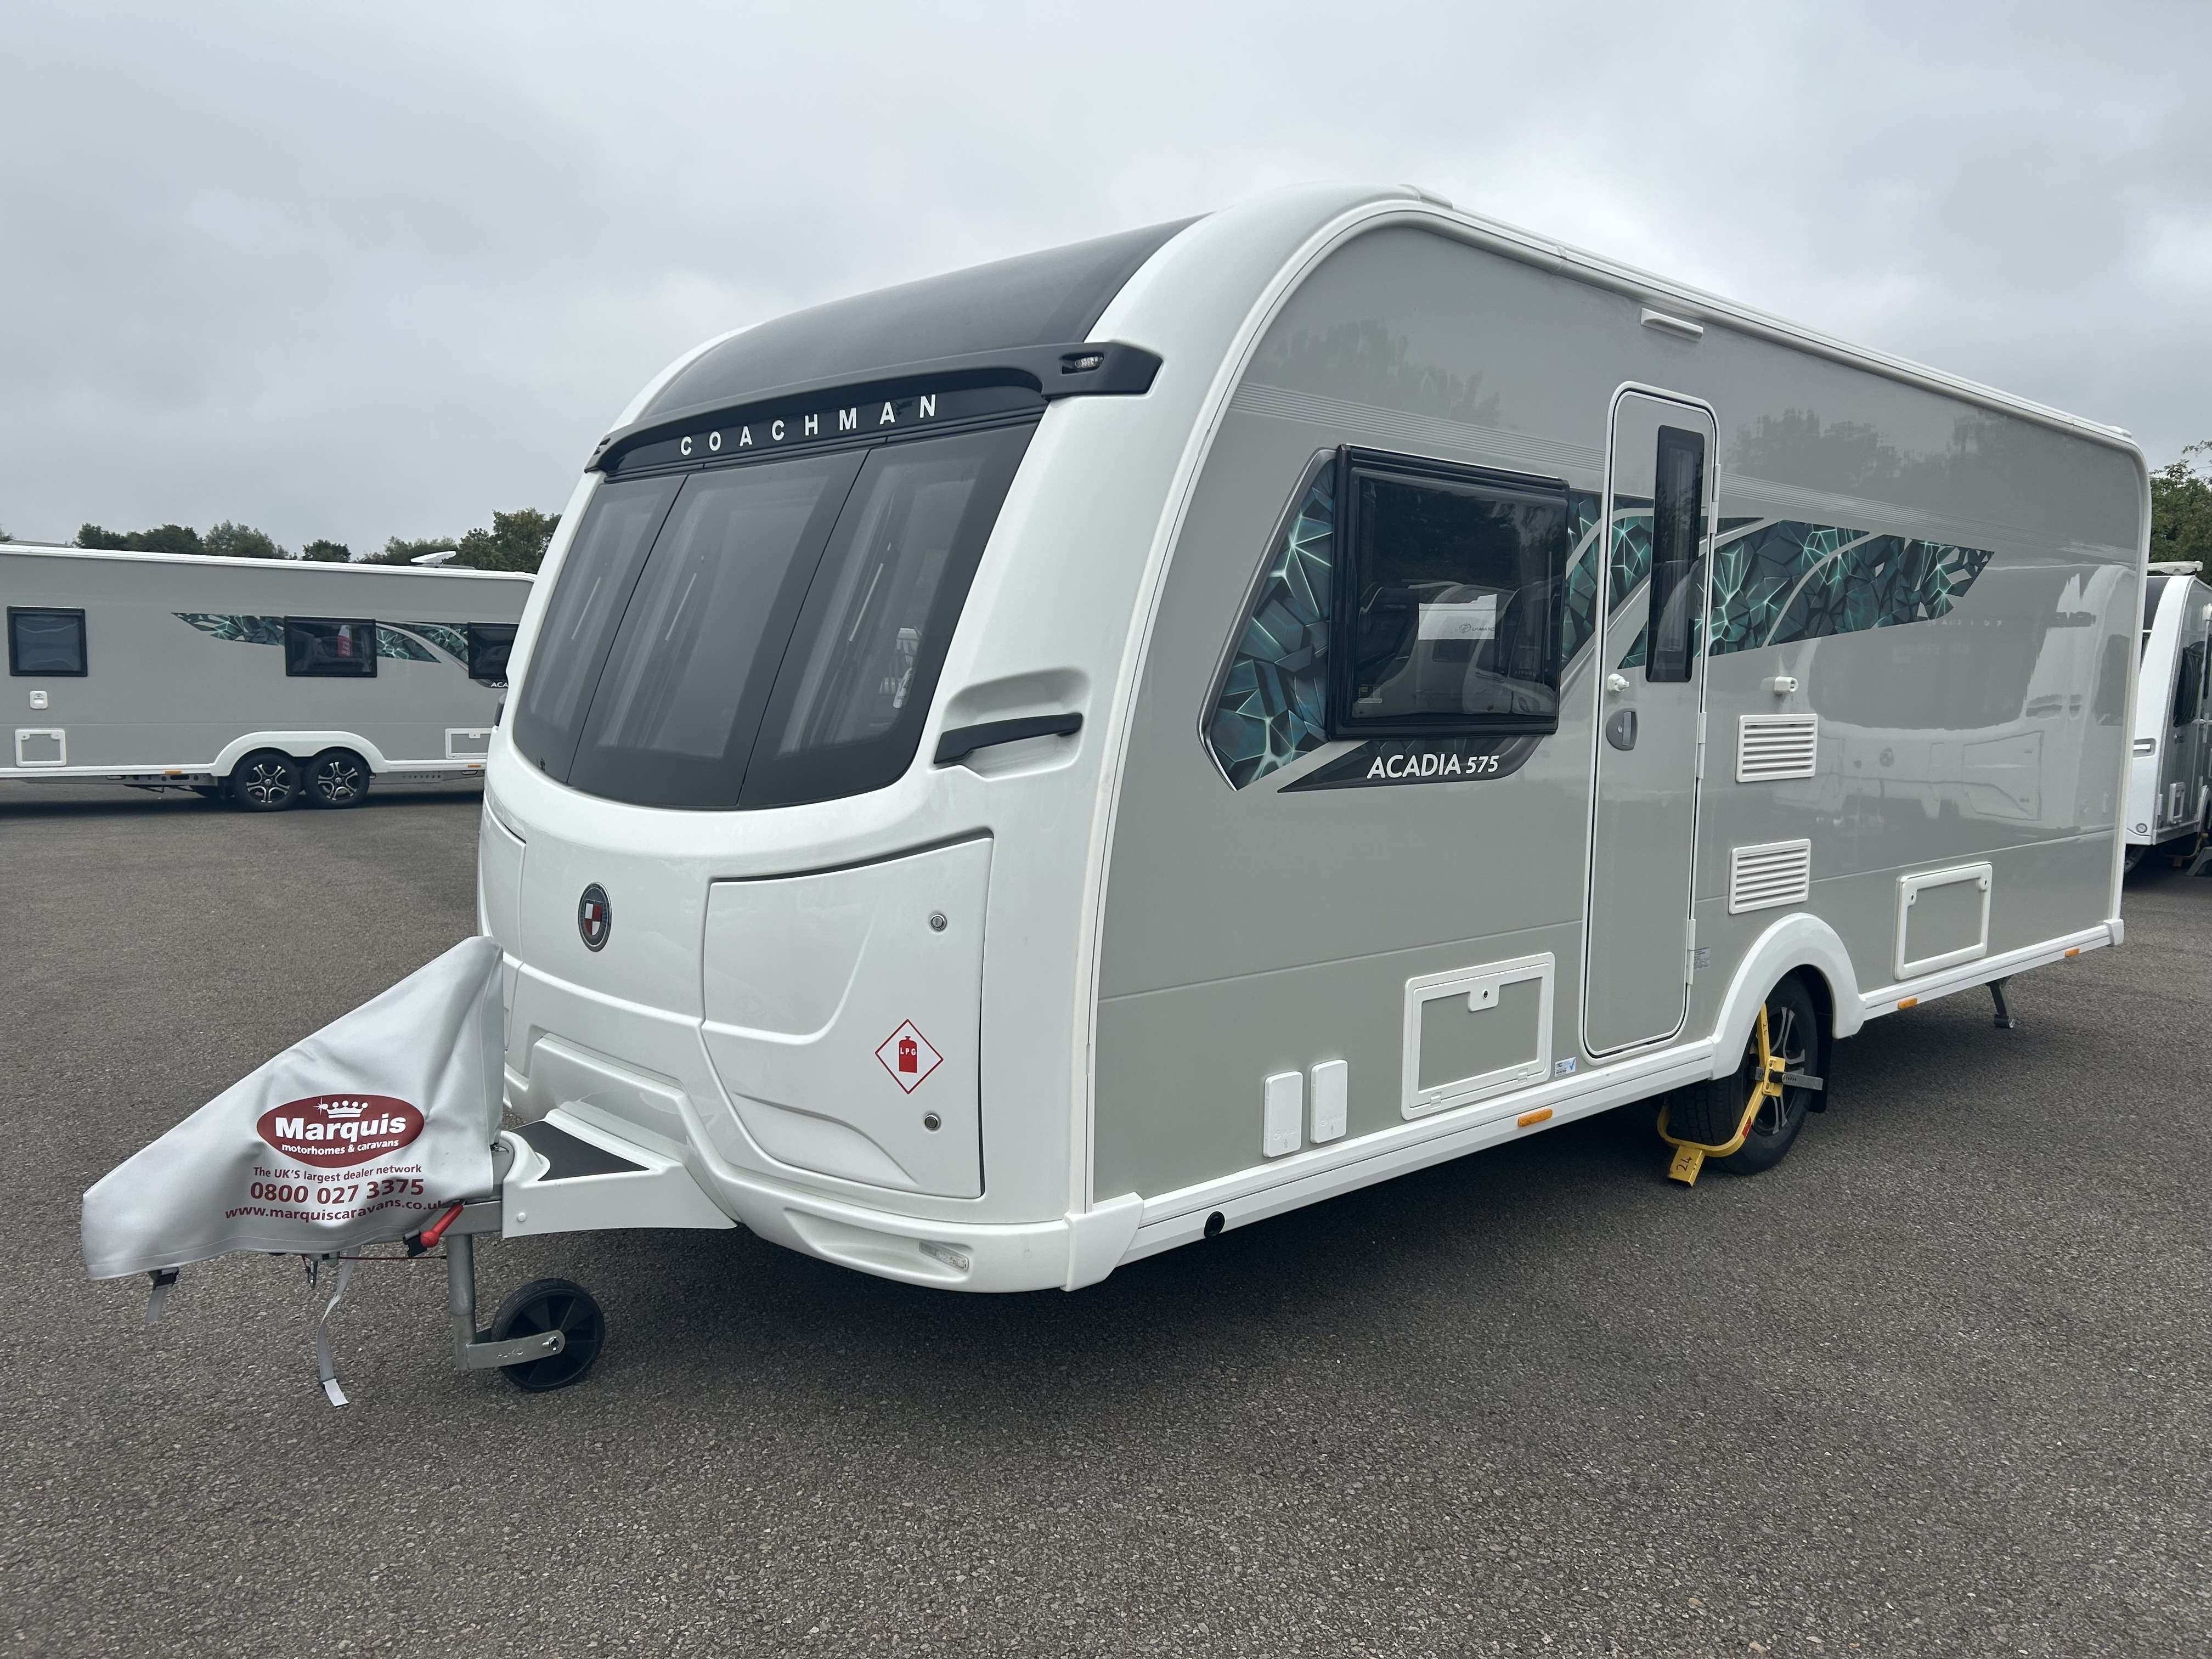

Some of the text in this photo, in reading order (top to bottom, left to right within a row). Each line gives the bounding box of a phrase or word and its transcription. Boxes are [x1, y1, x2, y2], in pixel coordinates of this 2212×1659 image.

[680, 393, 936, 456] COACHMAN
[1367, 753, 1499, 779] ACADIA 575
[900, 1047, 916, 1056] LPG
[275, 1113, 407, 1143] Marquis
[281, 1139, 399, 1155] motorhomes & caravans
[253, 1167, 271, 1177] The
[304, 1171, 341, 1183] largest
[343, 1168, 374, 1181] dealer
[376, 1164, 422, 1175] network
[1676, 1156, 1692, 1171] 24
[251, 1179, 424, 1204] 0800 027 3375
